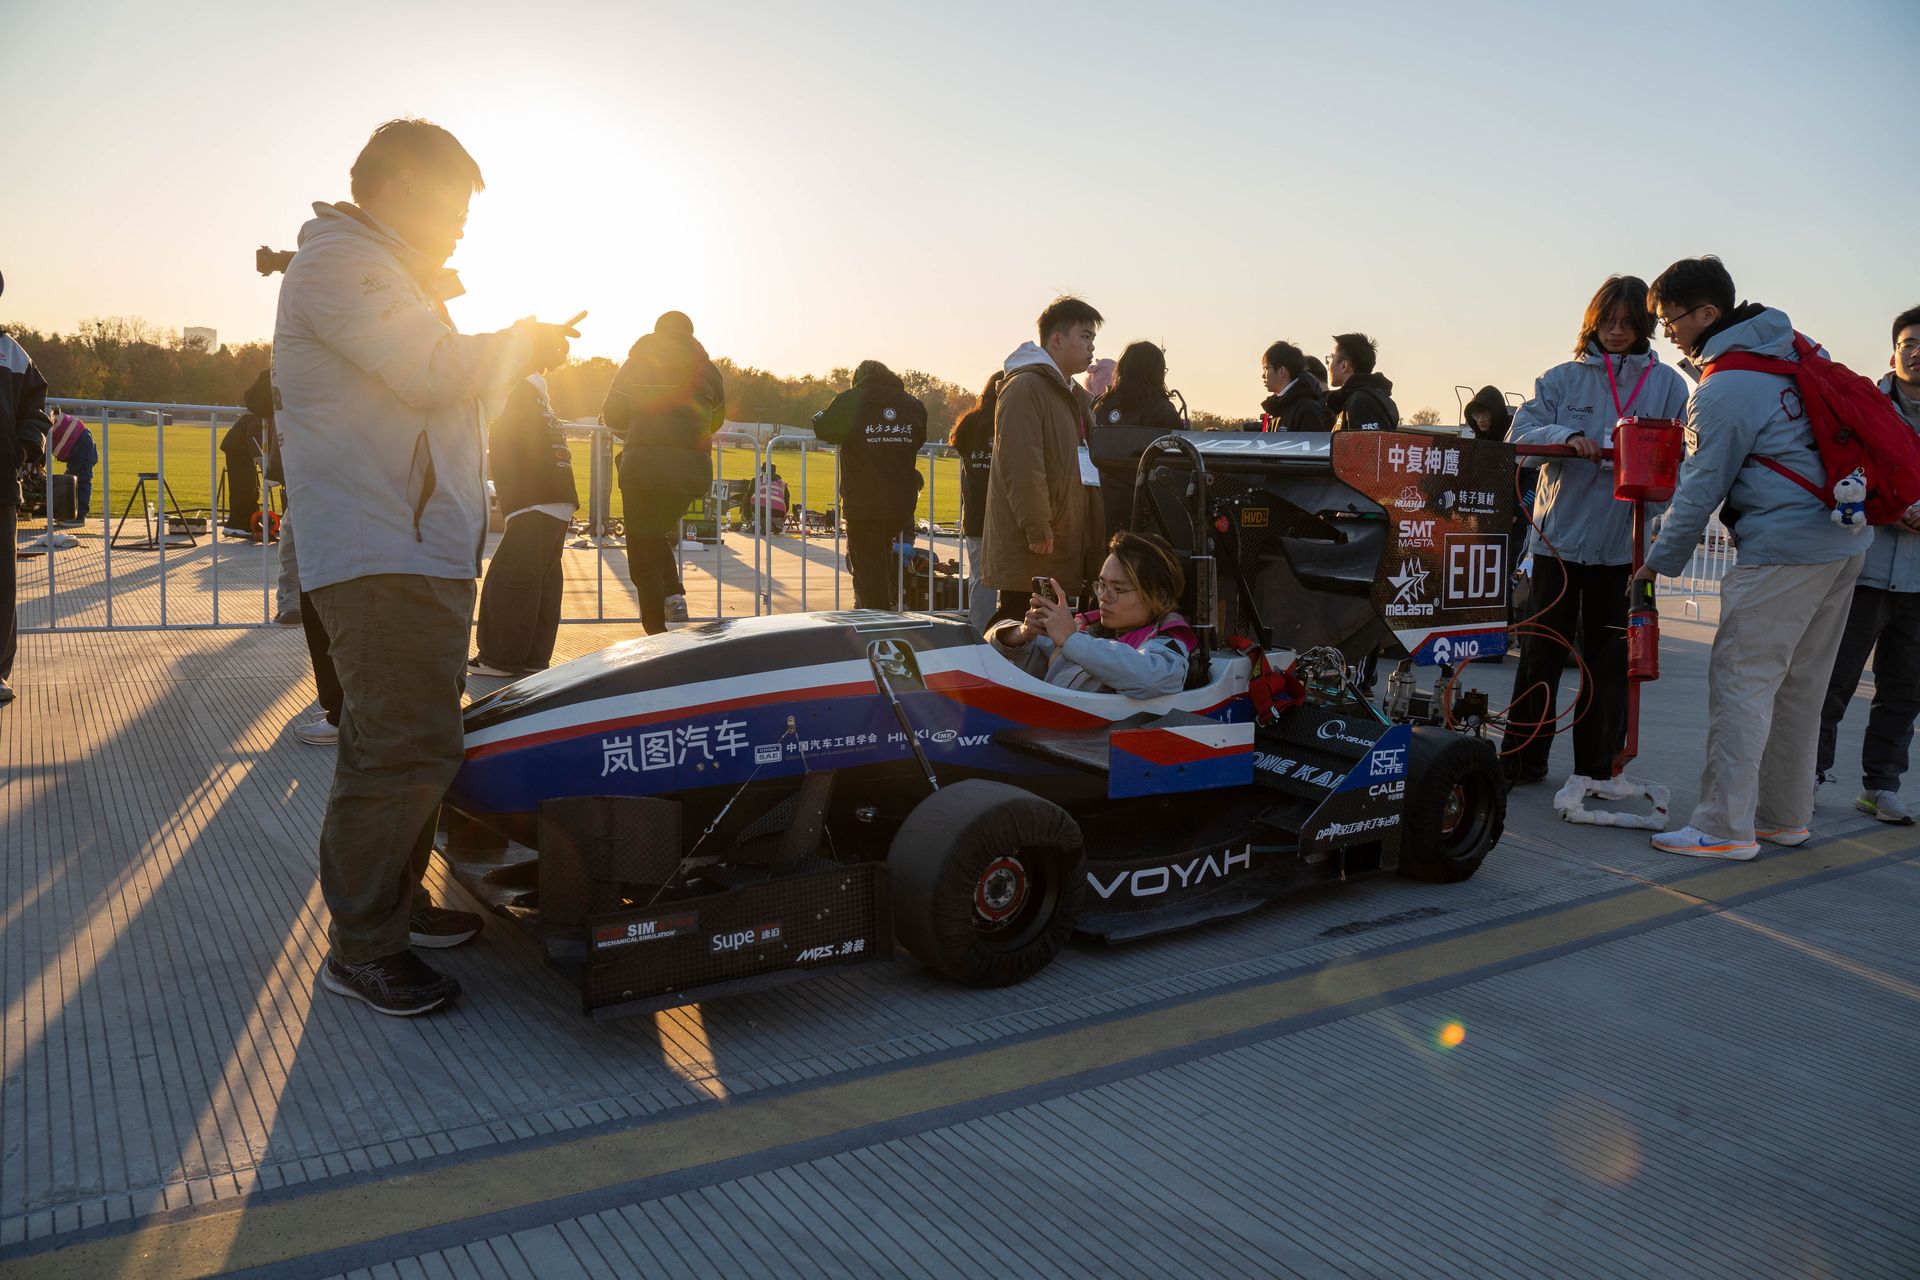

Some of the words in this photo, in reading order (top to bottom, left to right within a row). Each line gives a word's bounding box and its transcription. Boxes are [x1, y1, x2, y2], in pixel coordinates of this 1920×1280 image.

[1194, 439, 1330, 452] OYA
[1388, 444, 1460, 477] 中复神鹰
[712, 483, 728, 498] A7
[1399, 520, 1435, 538] SMT
[1398, 539, 1434, 547] MASTA
[1449, 545, 1501, 599] E03
[1455, 640, 1479, 657] NIO
[601, 719, 750, 777] 岚图汽车
[786, 733, 878, 753] 中国汽车工程学会
[759, 752, 779, 761] SAE
[1369, 780, 1405, 797] CALB
[1087, 844, 1250, 899] VOYAH
